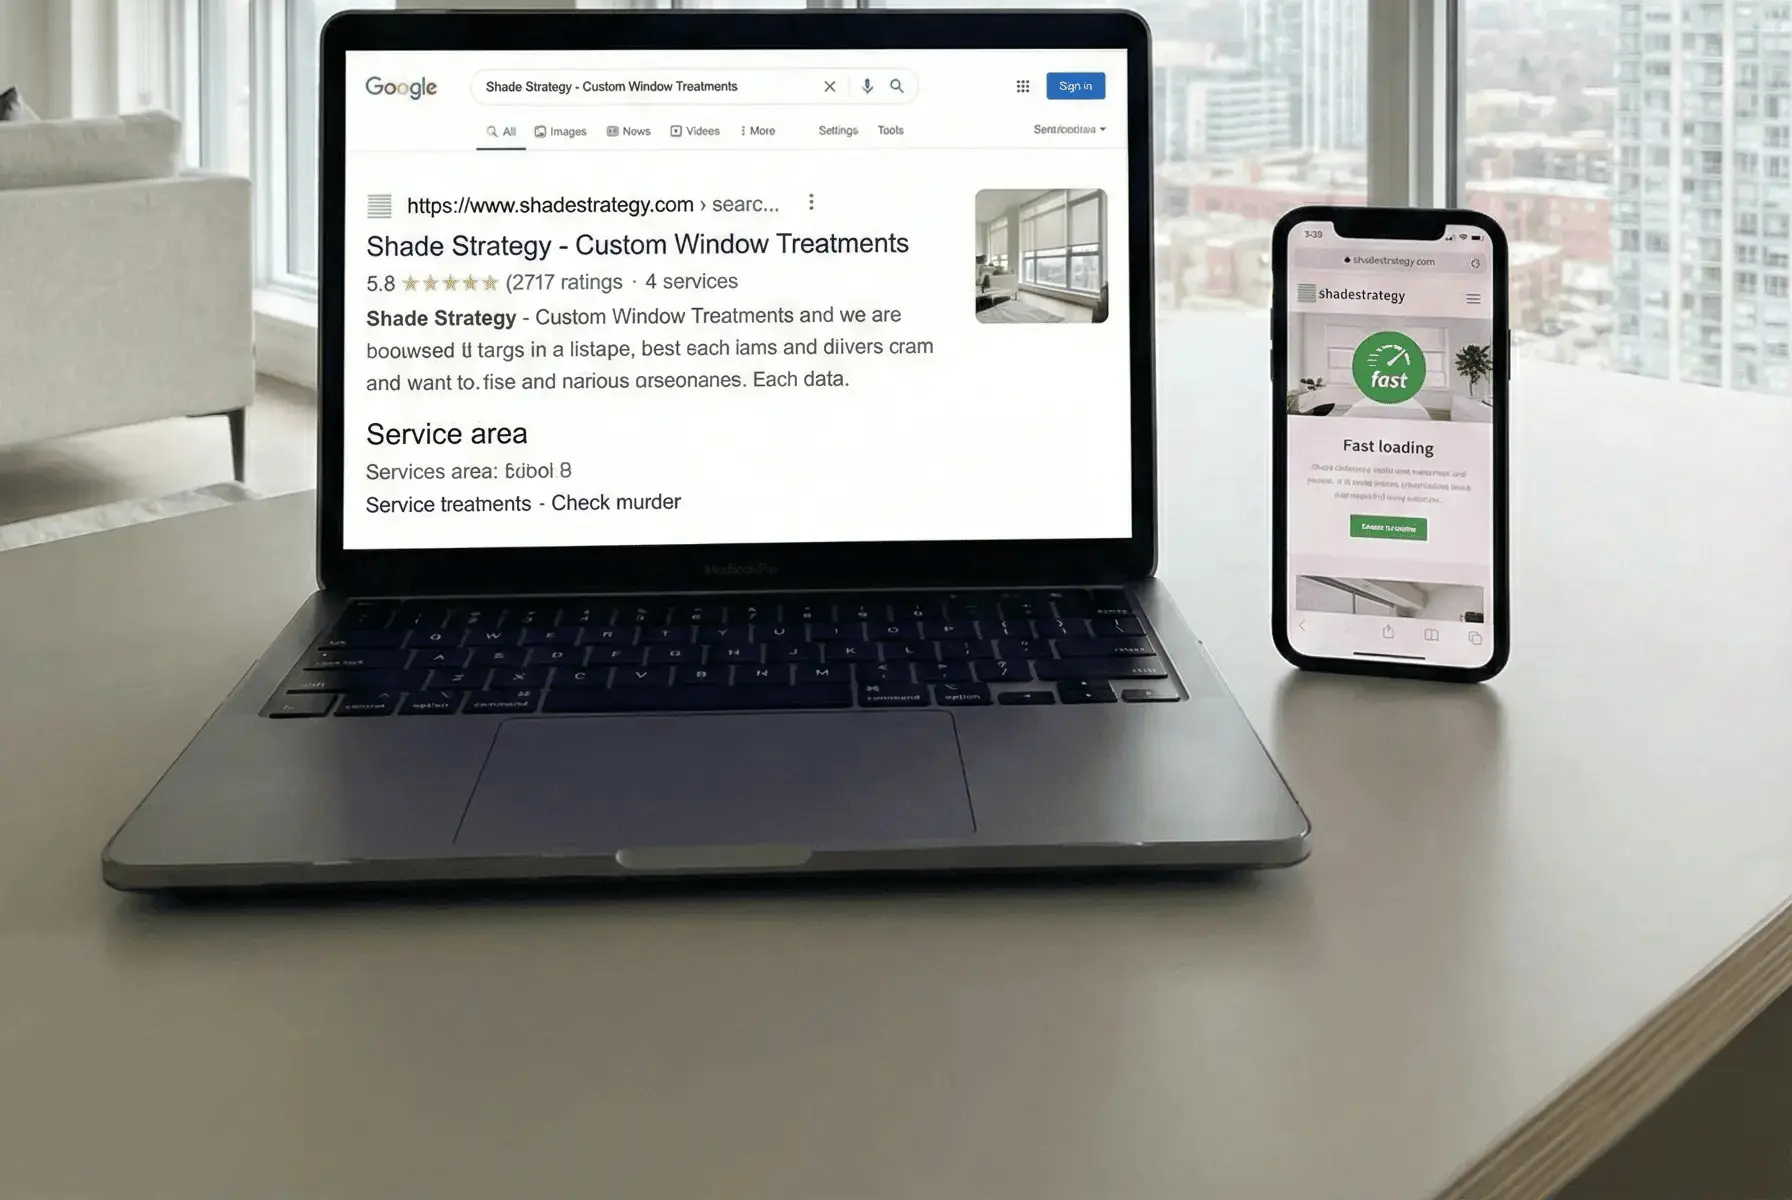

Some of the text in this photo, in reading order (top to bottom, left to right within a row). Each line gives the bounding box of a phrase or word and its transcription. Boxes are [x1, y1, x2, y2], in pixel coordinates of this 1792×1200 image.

[365, 76, 437, 100] Google
[486, 81, 522, 92] Shade
[525, 81, 572, 95] Strategy
[583, 81, 625, 92] Custom
[628, 81, 673, 92] Window
[676, 81, 738, 92] Treatments
[1059, 80, 1093, 93] Sign in
[503, 127, 516, 136] All
[551, 127, 587, 138] Images
[819, 126, 859, 137] Settings
[878, 125, 904, 135] Tools
[408, 196, 694, 218] https://www.shadestrategy.com
[367, 235, 444, 257] Shade
[452, 235, 552, 261] Strategy
[576, 234, 666, 255] Custom
[674, 233, 769, 254] Window
[776, 233, 909, 254] Treatments
[367, 273, 738, 294] 5.8 (2717 ratings 4 services
[1318, 288, 1406, 304] shadestrategy
[366, 310, 428, 326] Shade
[435, 310, 516, 330] Strategy
[536, 308, 606, 325] Custom
[612, 308, 685, 324] Window
[691, 307, 794, 324] Treatments
[800, 306, 833, 323] and
[840, 310, 866, 322] we
[872, 310, 901, 322] are
[477, 342, 524, 362] targs
[531, 341, 546, 357] in
[553, 345, 564, 357] a
[571, 341, 635, 360] listape,
[642, 340, 681, 356] best
[687, 339, 729, 356] each
[784, 338, 817, 355] and
[889, 341, 933, 354] cram
[366, 374, 400, 391] and
[407, 375, 452, 391] want
[522, 373, 555, 390] and
[563, 372, 629, 389] narious
[754, 371, 797, 387] Each
[804, 370, 849, 386] data.
[1371, 371, 1408, 389] fast
[367, 422, 527, 445] Service area
[1343, 439, 1435, 458] Fast loading
[366, 463, 445, 480] Services
[451, 466, 497, 479] area:
[366, 496, 435, 513] Service
[552, 494, 610, 511] Check
[617, 493, 682, 510] murder
